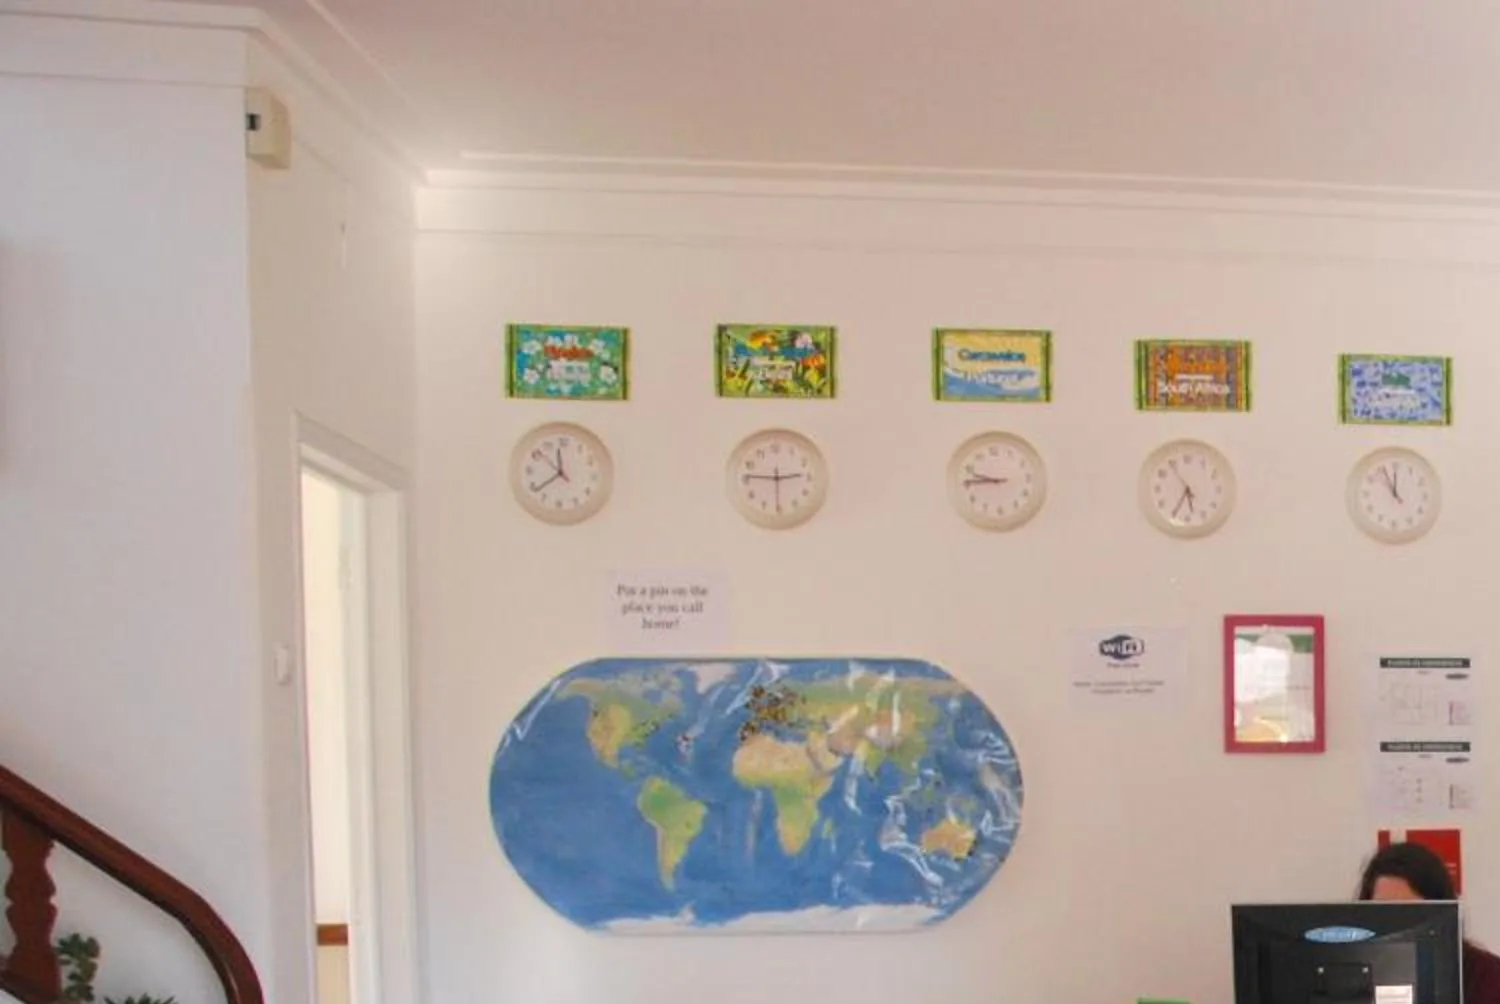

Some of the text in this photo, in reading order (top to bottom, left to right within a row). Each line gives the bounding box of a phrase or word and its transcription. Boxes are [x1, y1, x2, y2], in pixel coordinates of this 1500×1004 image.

[617, 583, 637, 597] Put
[650, 585, 669, 600] pin
[672, 586, 687, 597] on
[689, 584, 709, 597] the
[622, 600, 703, 616] place you call
[641, 616, 680, 629] home!
